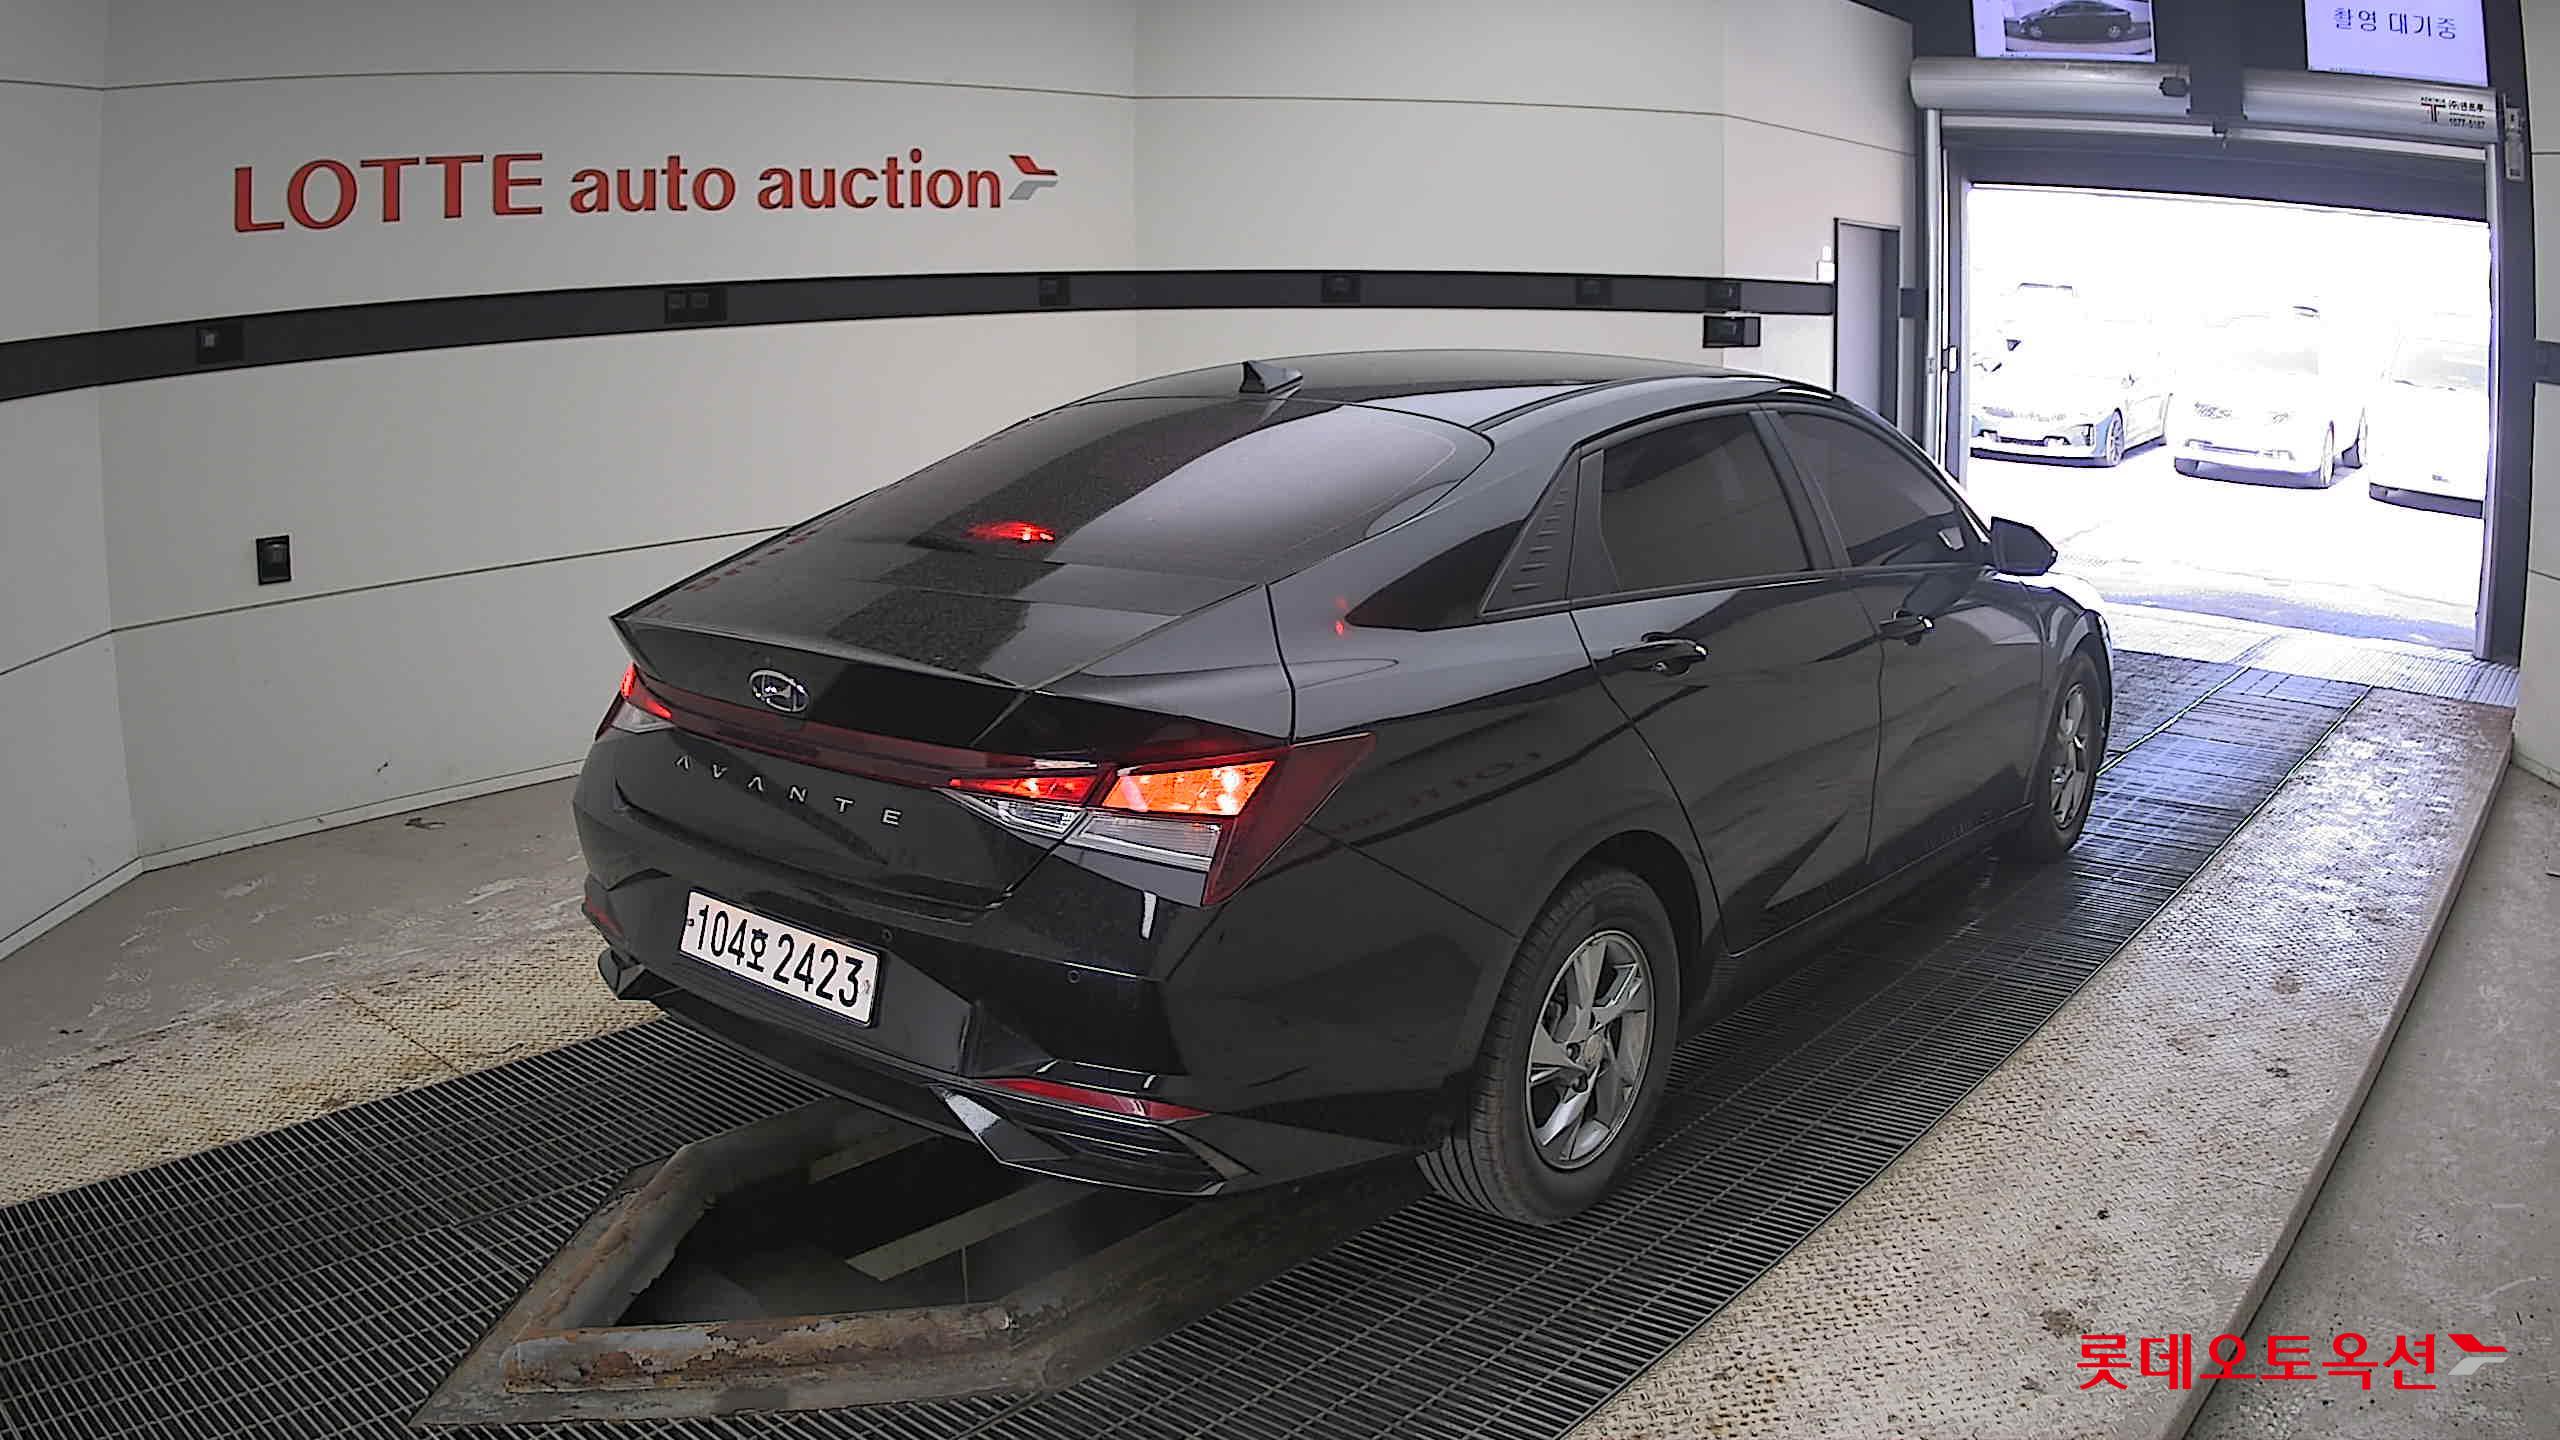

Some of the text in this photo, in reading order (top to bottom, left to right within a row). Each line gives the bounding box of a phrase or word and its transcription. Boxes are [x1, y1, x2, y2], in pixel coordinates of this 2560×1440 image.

[2388, 13, 2457, 40] 대기중
[235, 148, 1002, 232] LOTTE auto auction
[674, 755, 902, 826] AVANTE
[773, 933, 864, 1008] 2423
